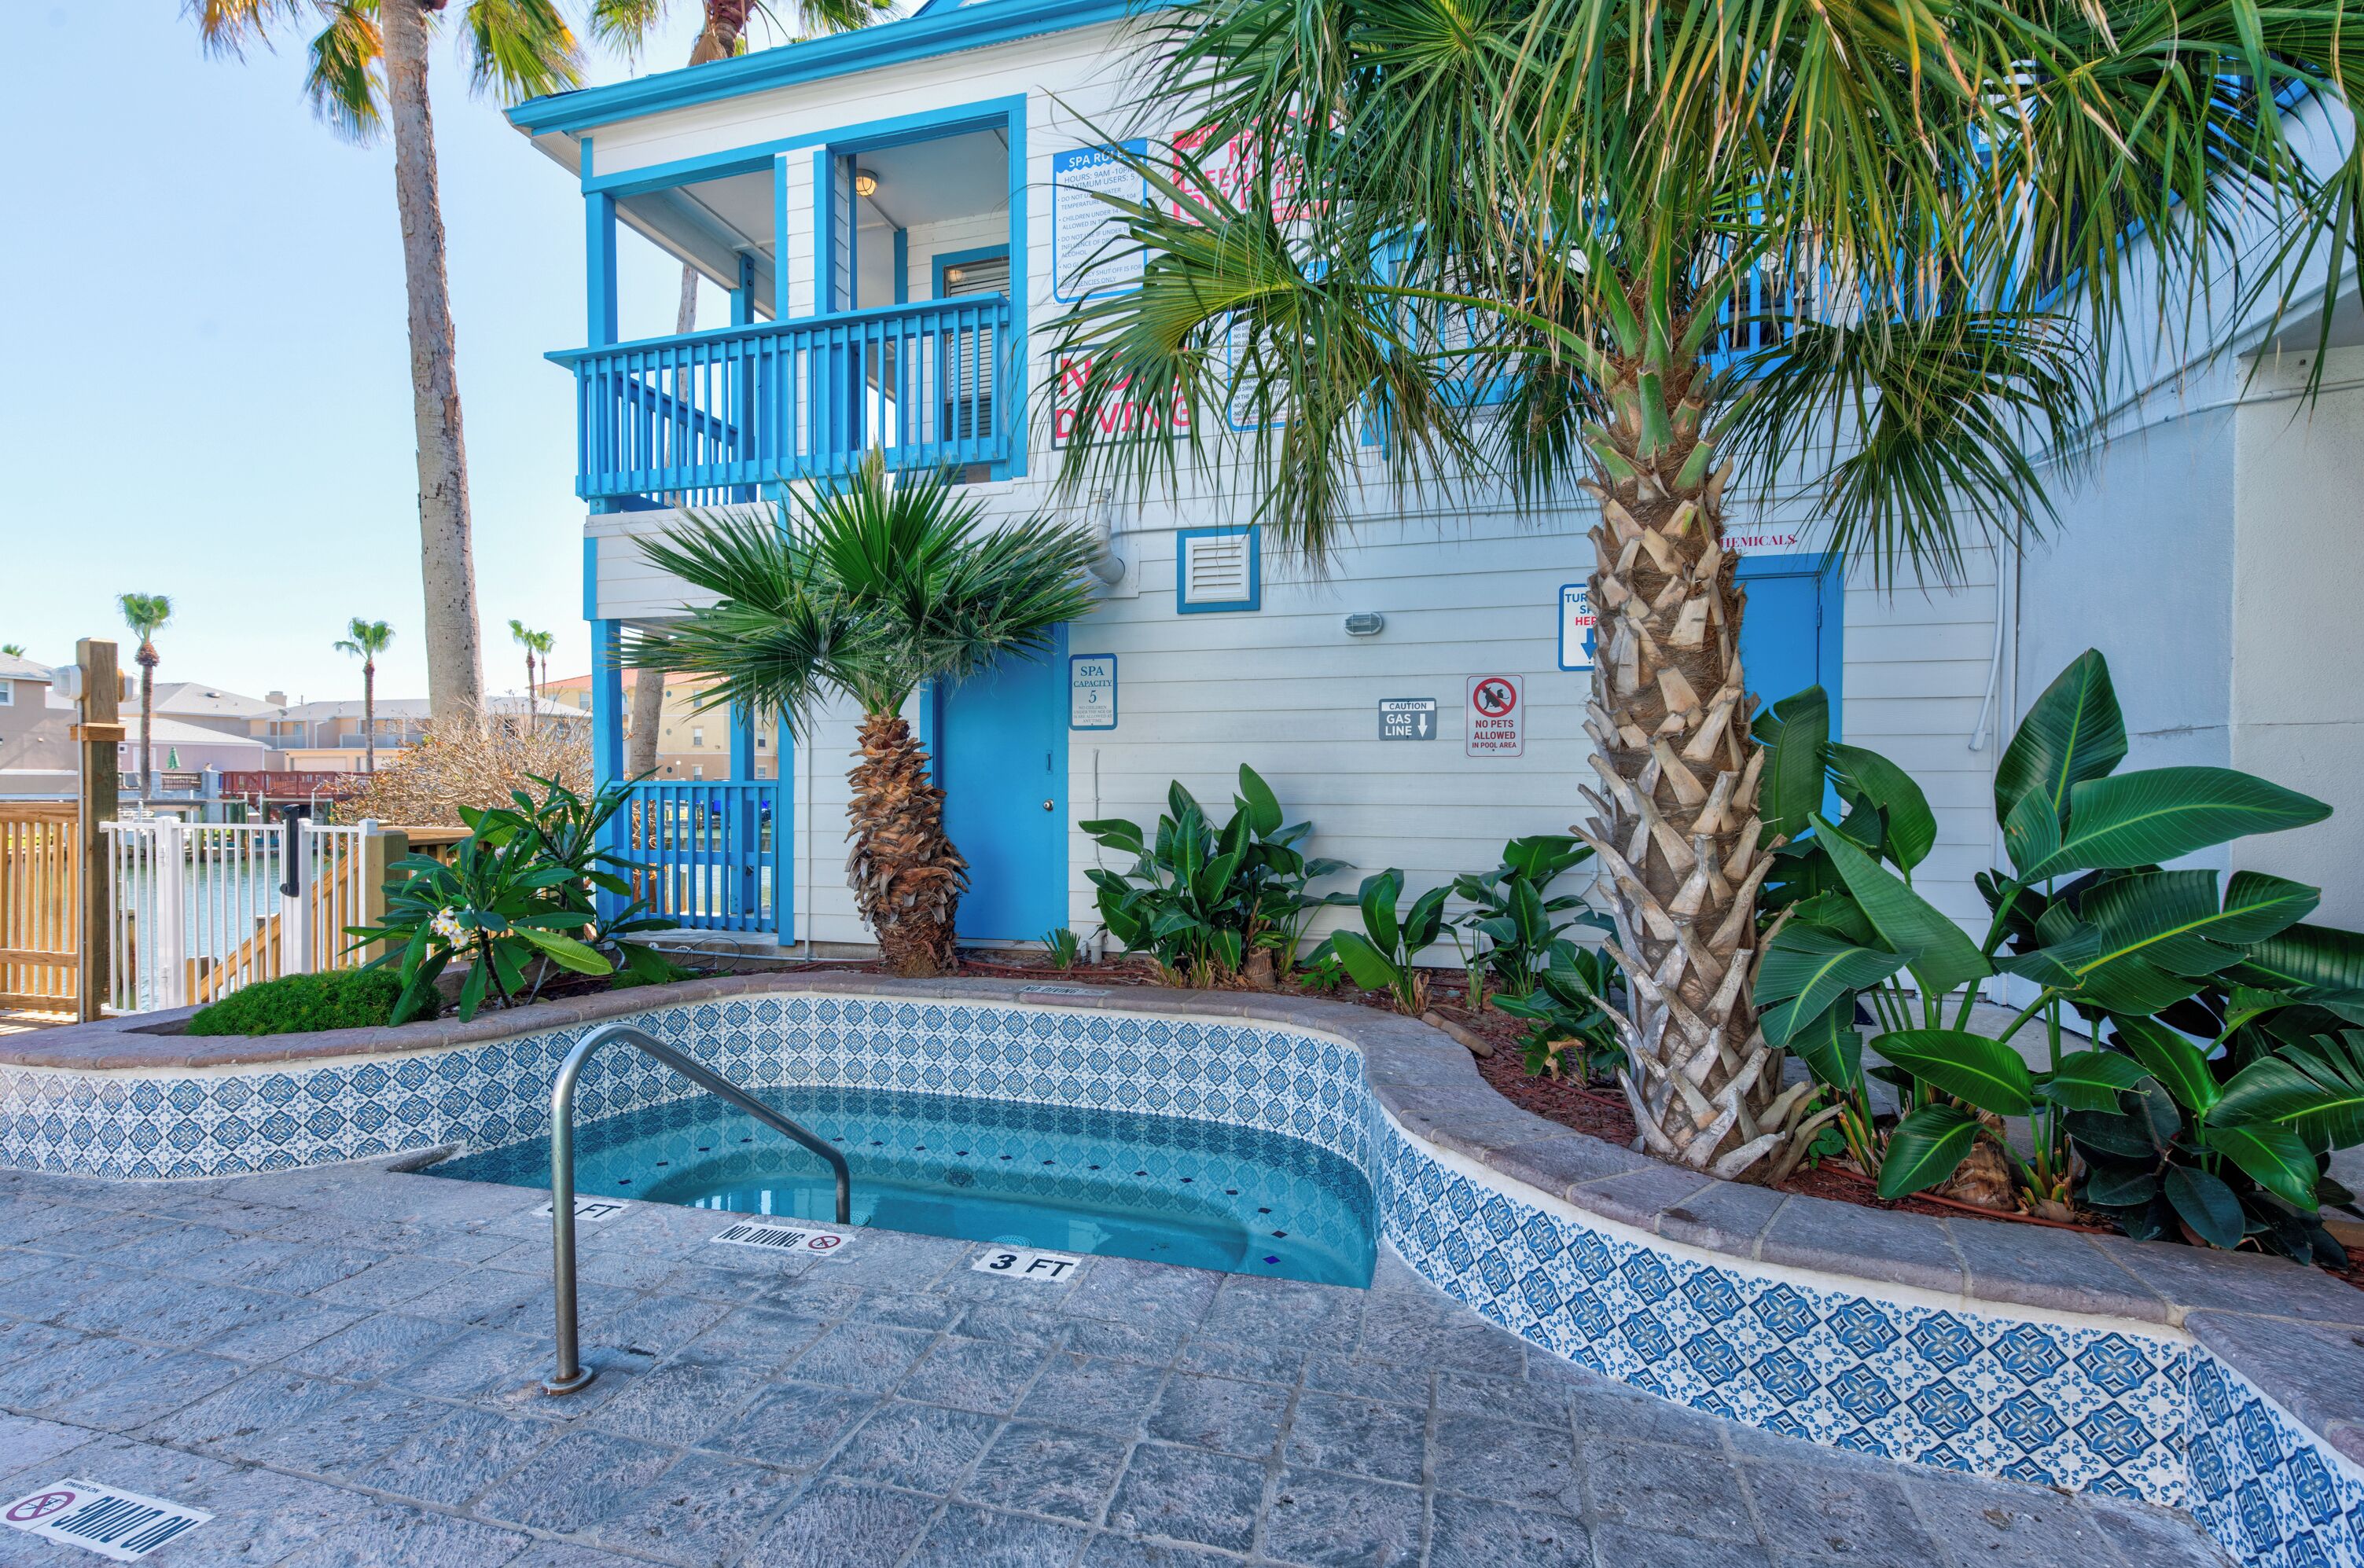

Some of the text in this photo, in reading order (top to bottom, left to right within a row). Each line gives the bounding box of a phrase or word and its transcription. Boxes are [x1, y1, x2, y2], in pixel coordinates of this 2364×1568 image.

[1069, 155, 1090, 167] SPA
[1064, 174, 1092, 184] HOURS:
[1094, 170, 1110, 178] 9AM
[1103, 174, 1129, 185] USERS:
[1061, 200, 1101, 211] TEMPERATURE
[1062, 213, 1090, 222] CHILDREN
[1091, 208, 1111, 218] UNDER
[1062, 221, 1089, 230] ALLOWED
[1096, 268, 1112, 277] SHUT
[1720, 534, 1796, 548] HEMICALS
[1080, 666, 1105, 677] SPA
[1088, 690, 1097, 703] 5
[1386, 714, 1411, 724] GAS
[1491, 719, 1514, 728] PETS
[1385, 725, 1412, 736] LINE
[1473, 731, 1516, 740] ALLOWED
[575, 1203, 623, 1218] FT
[718, 1225, 806, 1248] NO DIVING
[989, 1254, 1074, 1276] 3 FT
[64, 1481, 90, 1491] DIVING
[51, 1495, 199, 1554] NO DIVING
